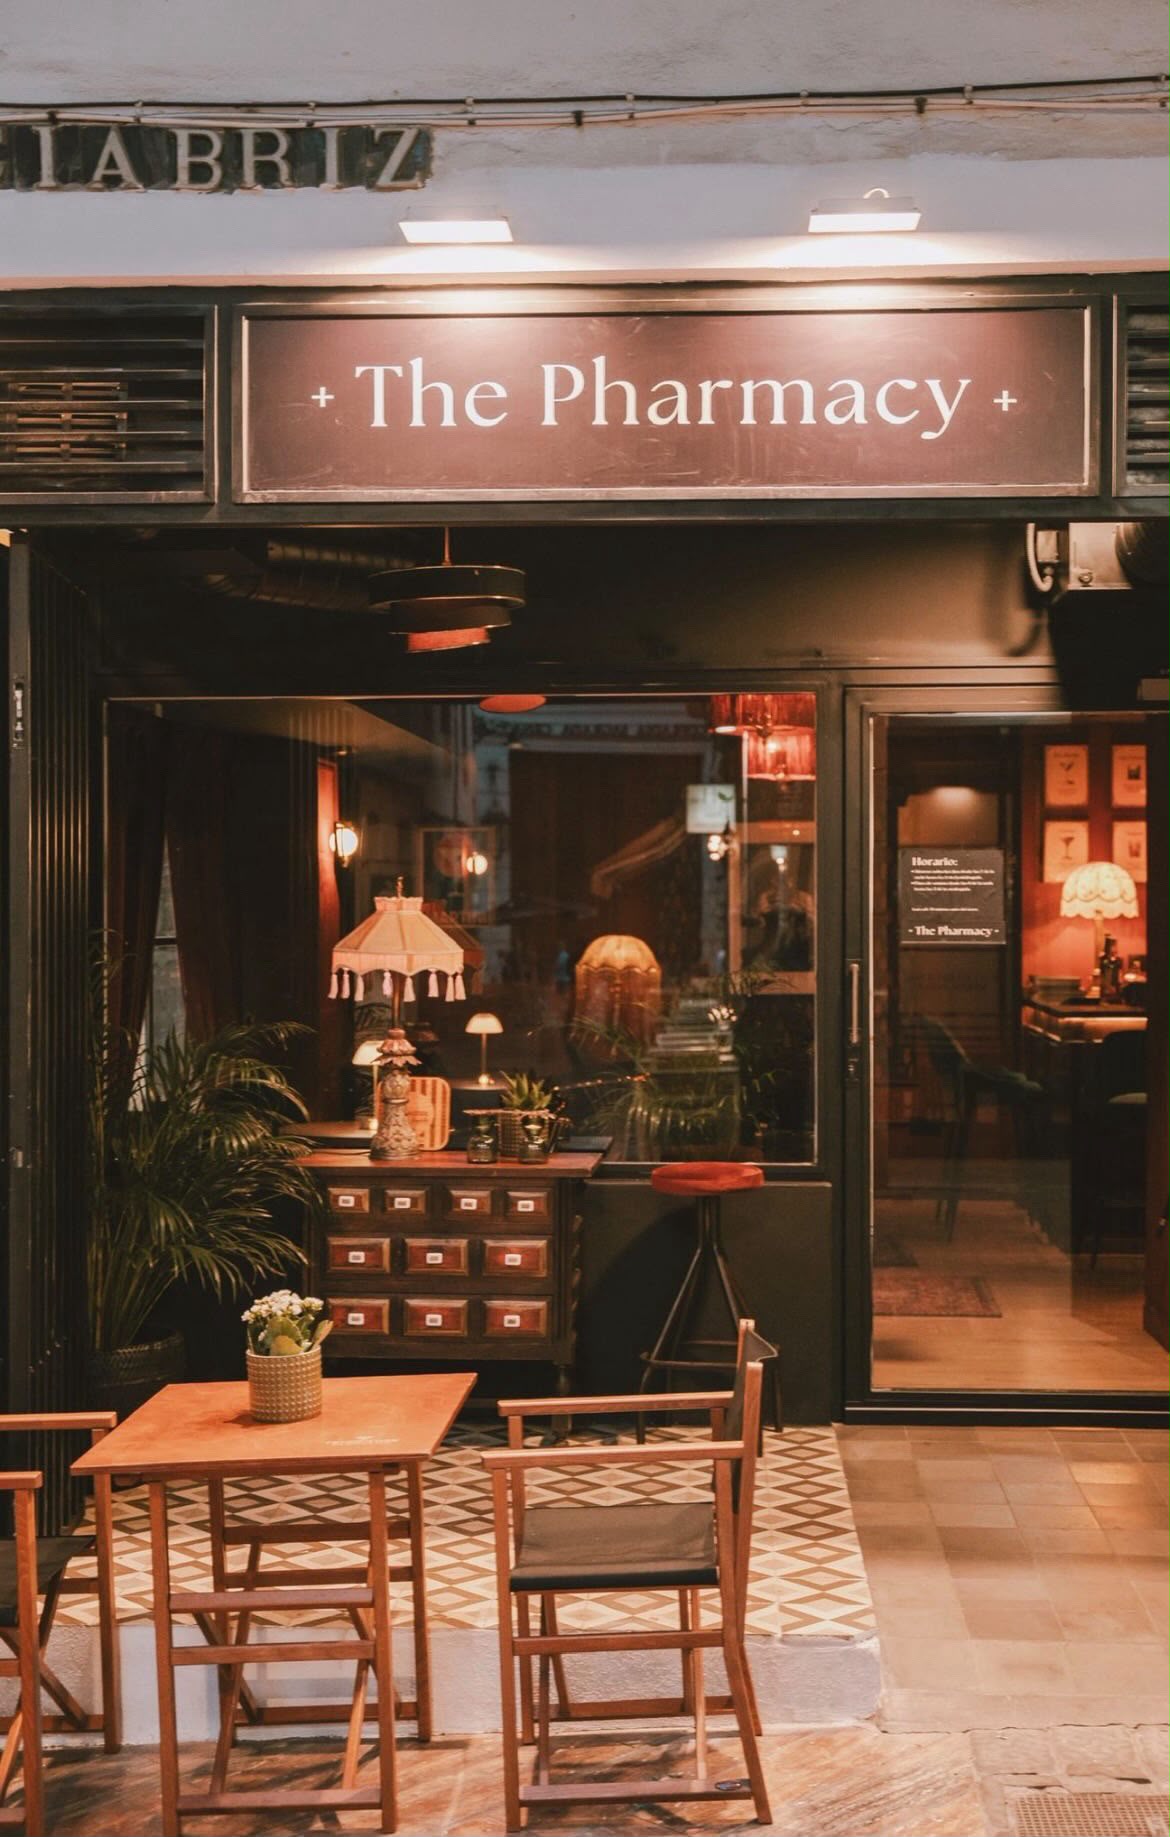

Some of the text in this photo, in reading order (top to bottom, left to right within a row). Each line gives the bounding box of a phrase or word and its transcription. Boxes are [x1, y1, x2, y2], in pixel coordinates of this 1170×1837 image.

[0, 126, 425, 190] IABRIZ
[354, 355, 973, 441] The Pharmacy
[914, 926, 993, 937] The Pharmacy
